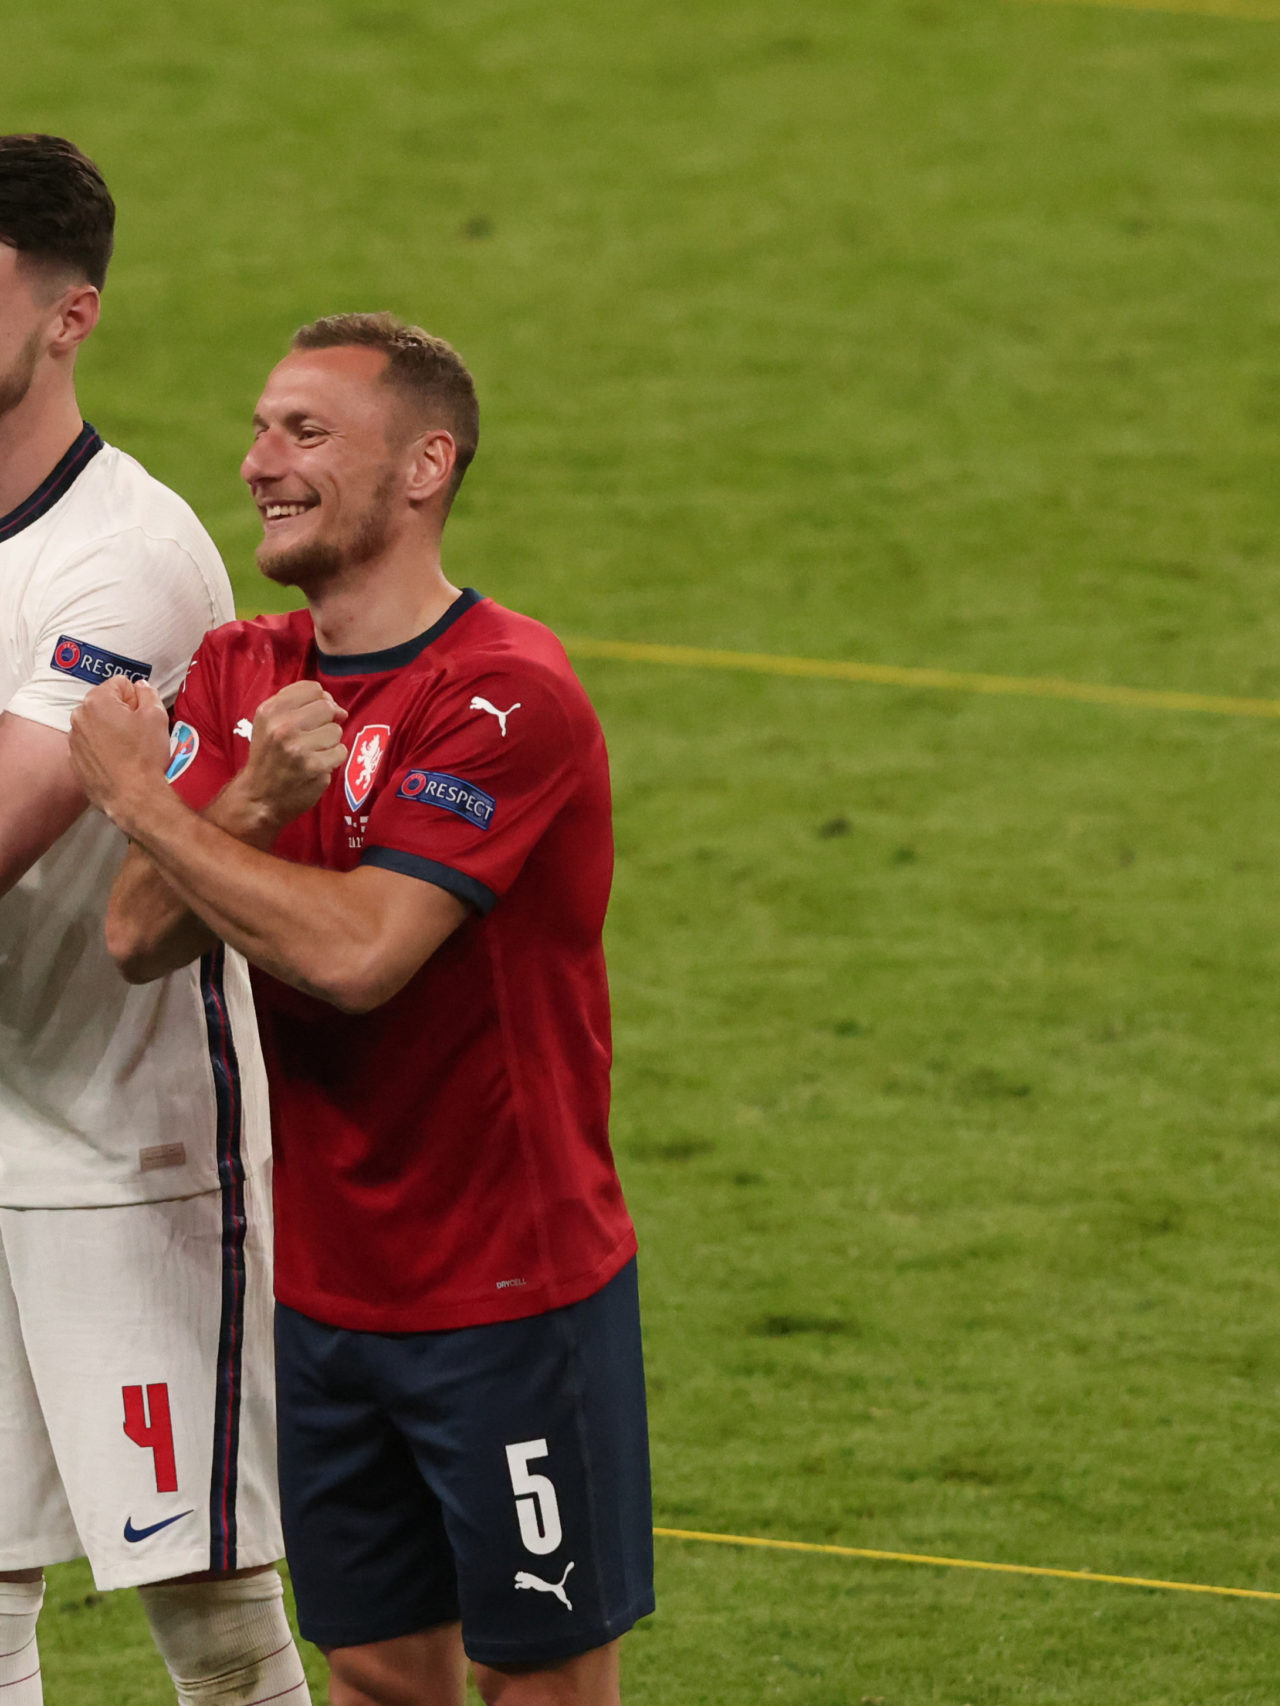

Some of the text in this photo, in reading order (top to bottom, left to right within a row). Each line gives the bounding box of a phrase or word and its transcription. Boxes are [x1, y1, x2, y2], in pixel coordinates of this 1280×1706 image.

[425, 781, 494, 820] RESPECT
[122, 1383, 178, 1493] 4
[505, 1438, 562, 1555] 5
